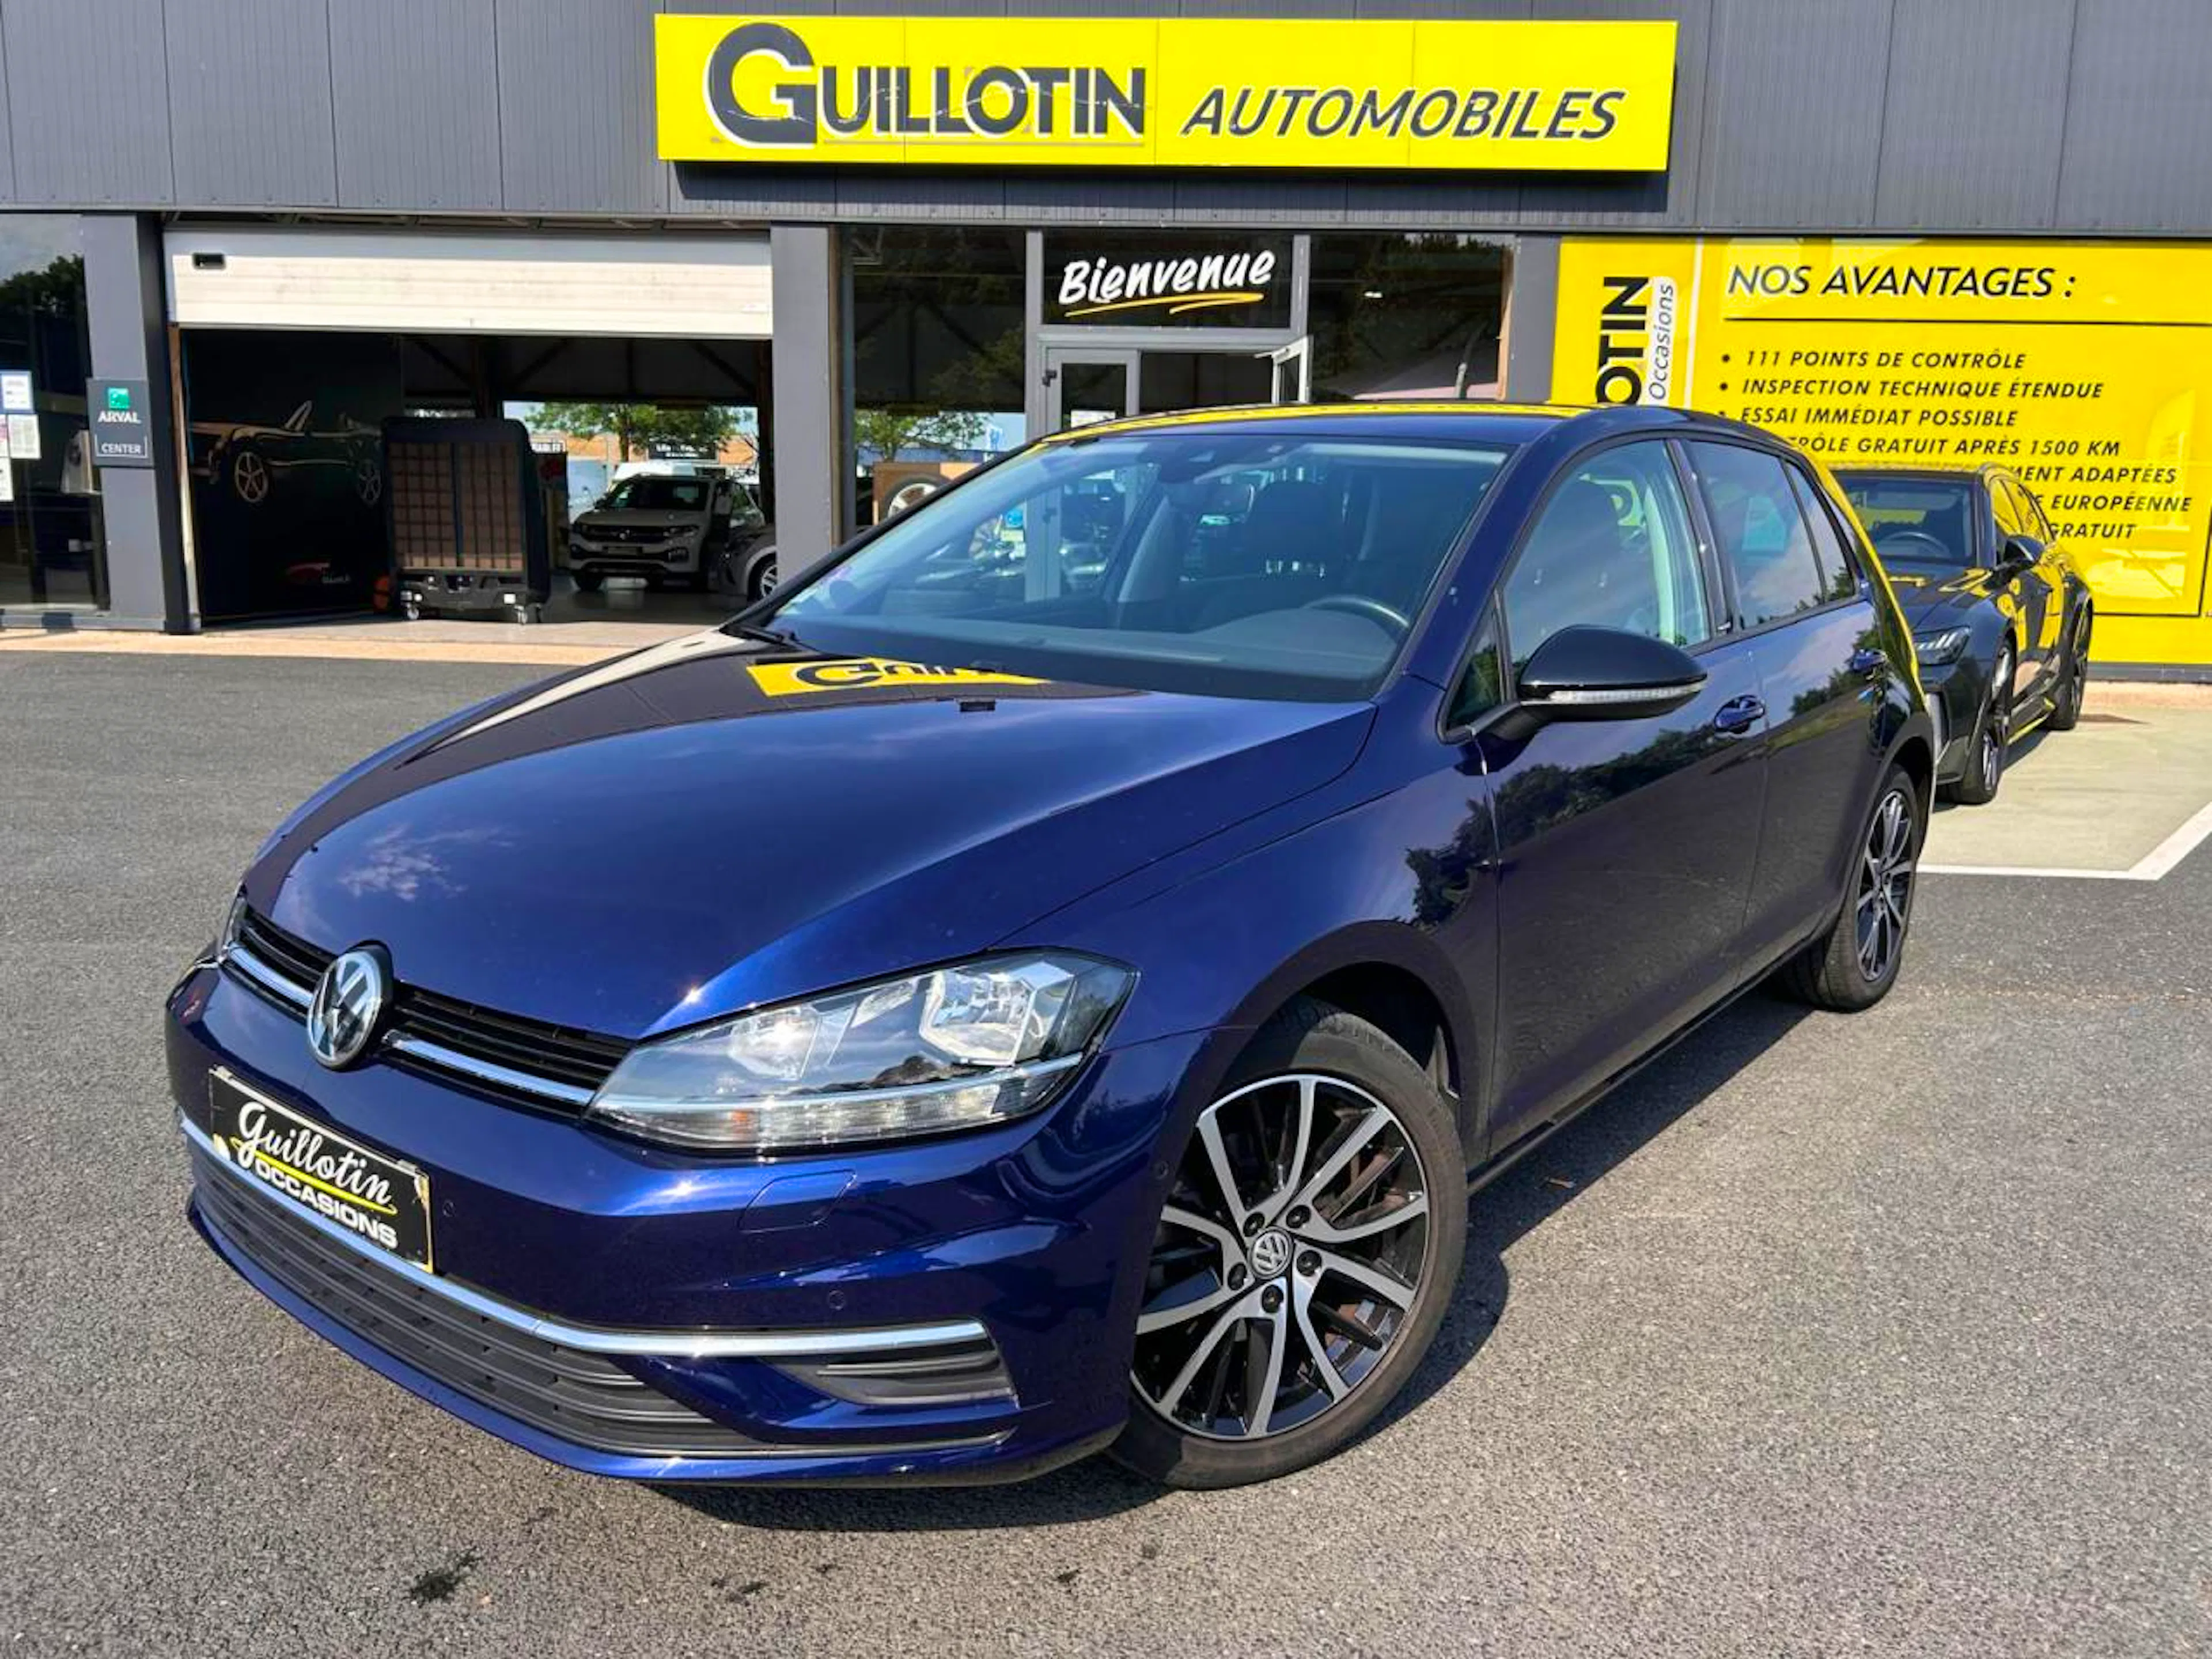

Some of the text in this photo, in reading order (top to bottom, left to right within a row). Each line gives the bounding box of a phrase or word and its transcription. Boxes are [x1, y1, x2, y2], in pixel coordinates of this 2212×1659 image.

[1181, 88, 1627, 140] AUTOMOBILES
[1058, 249, 1276, 305] Bienvenue
[1728, 265, 1812, 296] NOS
[1820, 266, 2056, 298] AVANTAGES
[1595, 276, 1649, 404] OTIN
[1648, 284, 1674, 400] Occasions
[1748, 347, 2027, 370] 111 POINTS DE CONTRÔLE
[1743, 377, 2104, 399] INSPECTION TECHNIQUE ÉTENDUE
[97, 410, 142, 425] ARVAL
[1741, 403, 2018, 427] ESSAI IMMÉDIAT POSSIBLE
[101, 442, 142, 454] CENTER
[1857, 438, 1949, 454] GRATUIT
[1954, 434, 2021, 456] APRÈS
[2031, 440, 2080, 456] 1500
[2088, 441, 2120, 457] KM
[2070, 463, 2177, 484] ADAPTÉES
[2051, 490, 2192, 513] EUROPÉENNE
[255, 1158, 399, 1249] OCCASIONS
